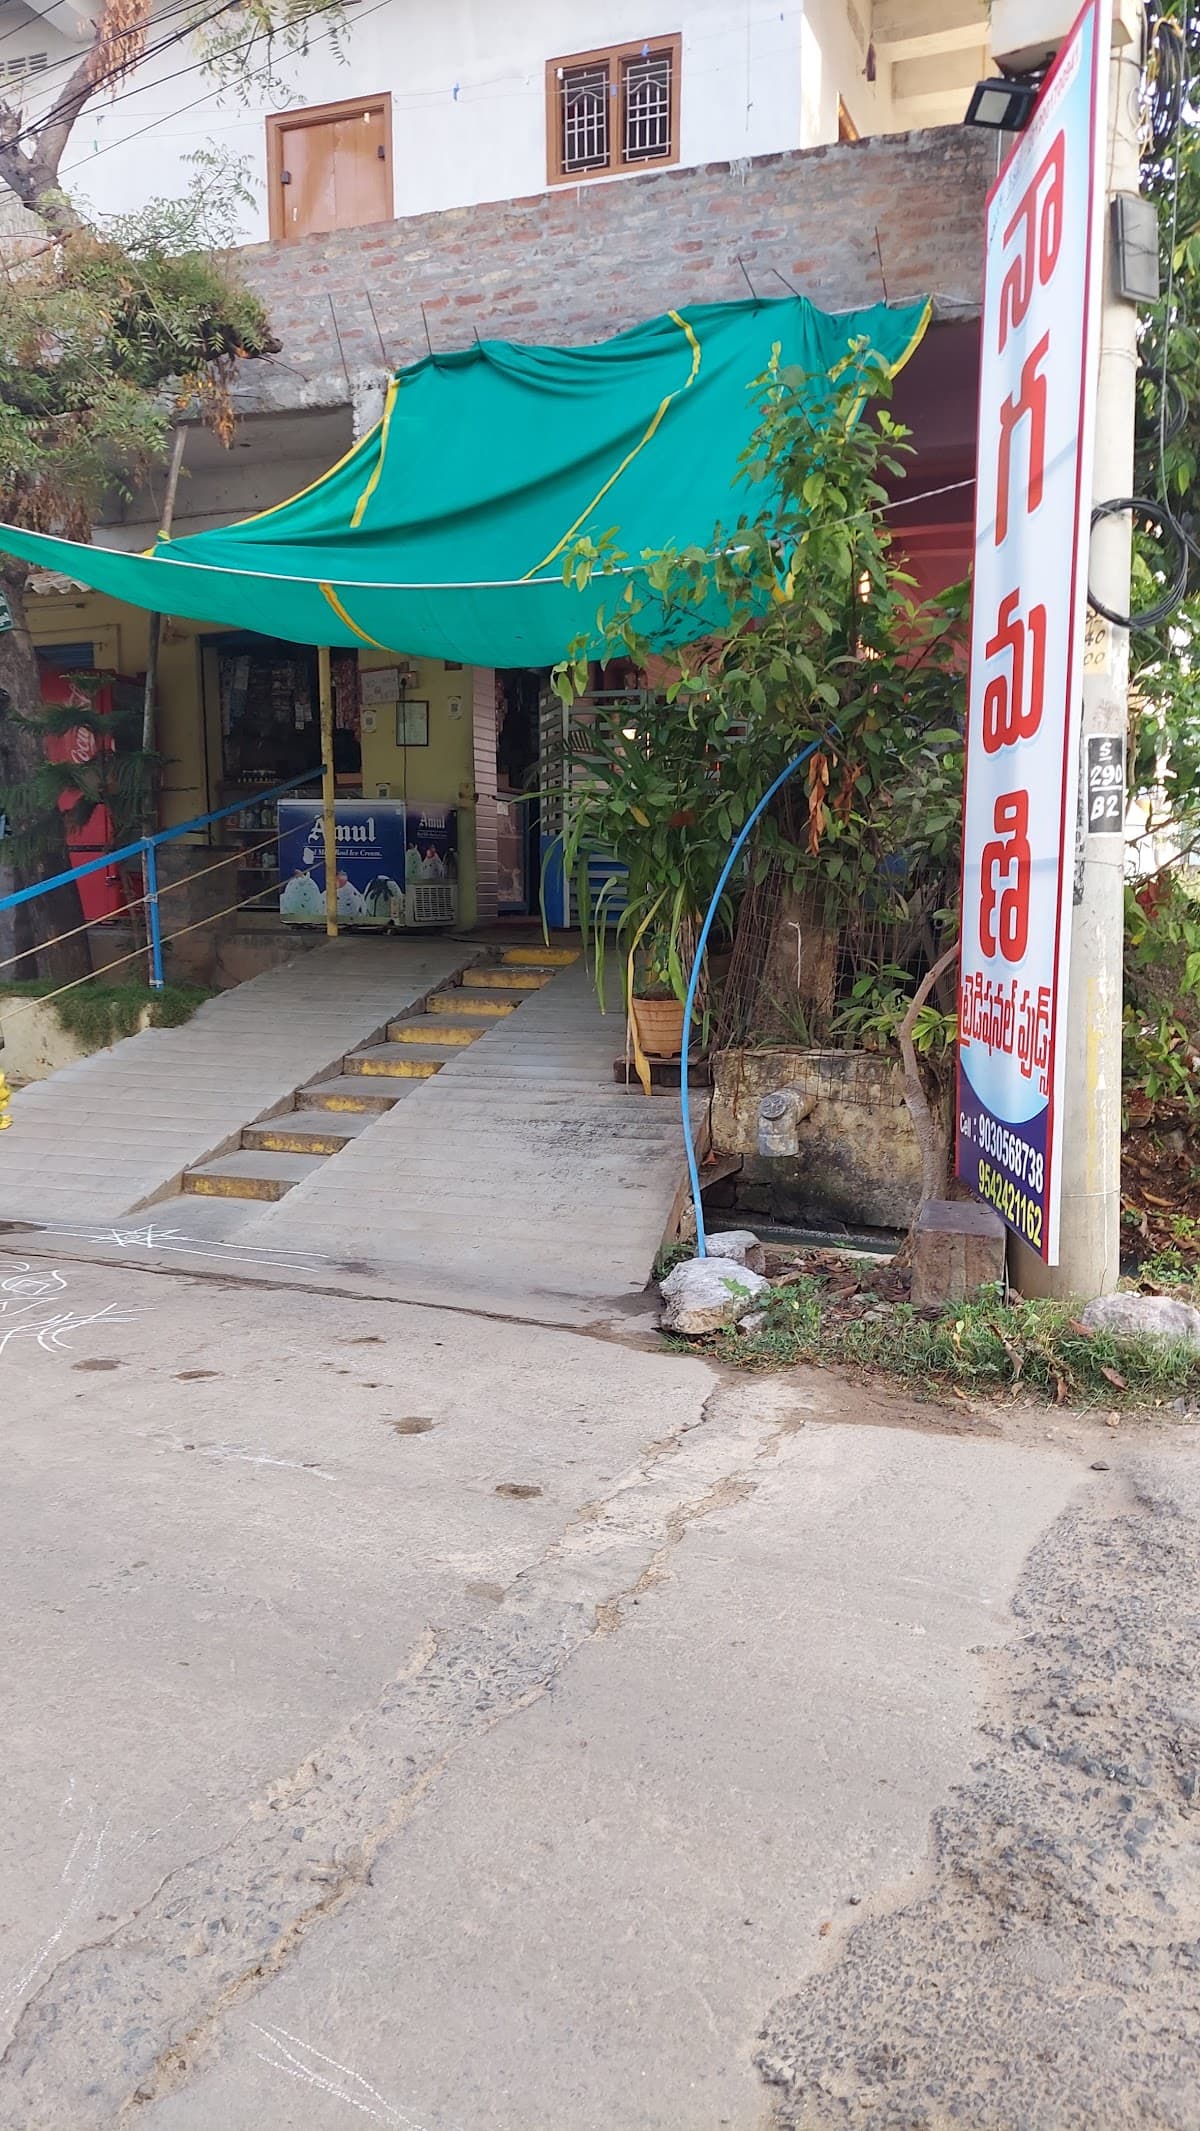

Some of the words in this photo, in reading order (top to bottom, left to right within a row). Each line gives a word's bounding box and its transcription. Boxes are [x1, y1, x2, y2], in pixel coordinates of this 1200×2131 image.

[1099, 742, 1112, 756] S
[1090, 764, 1122, 787] 290
[1090, 795, 1119, 821] B2
[308, 815, 376, 844] Amul
[979, 1114, 1044, 1193] 9030568738
[978, 1159, 1042, 1248] 9542421162
